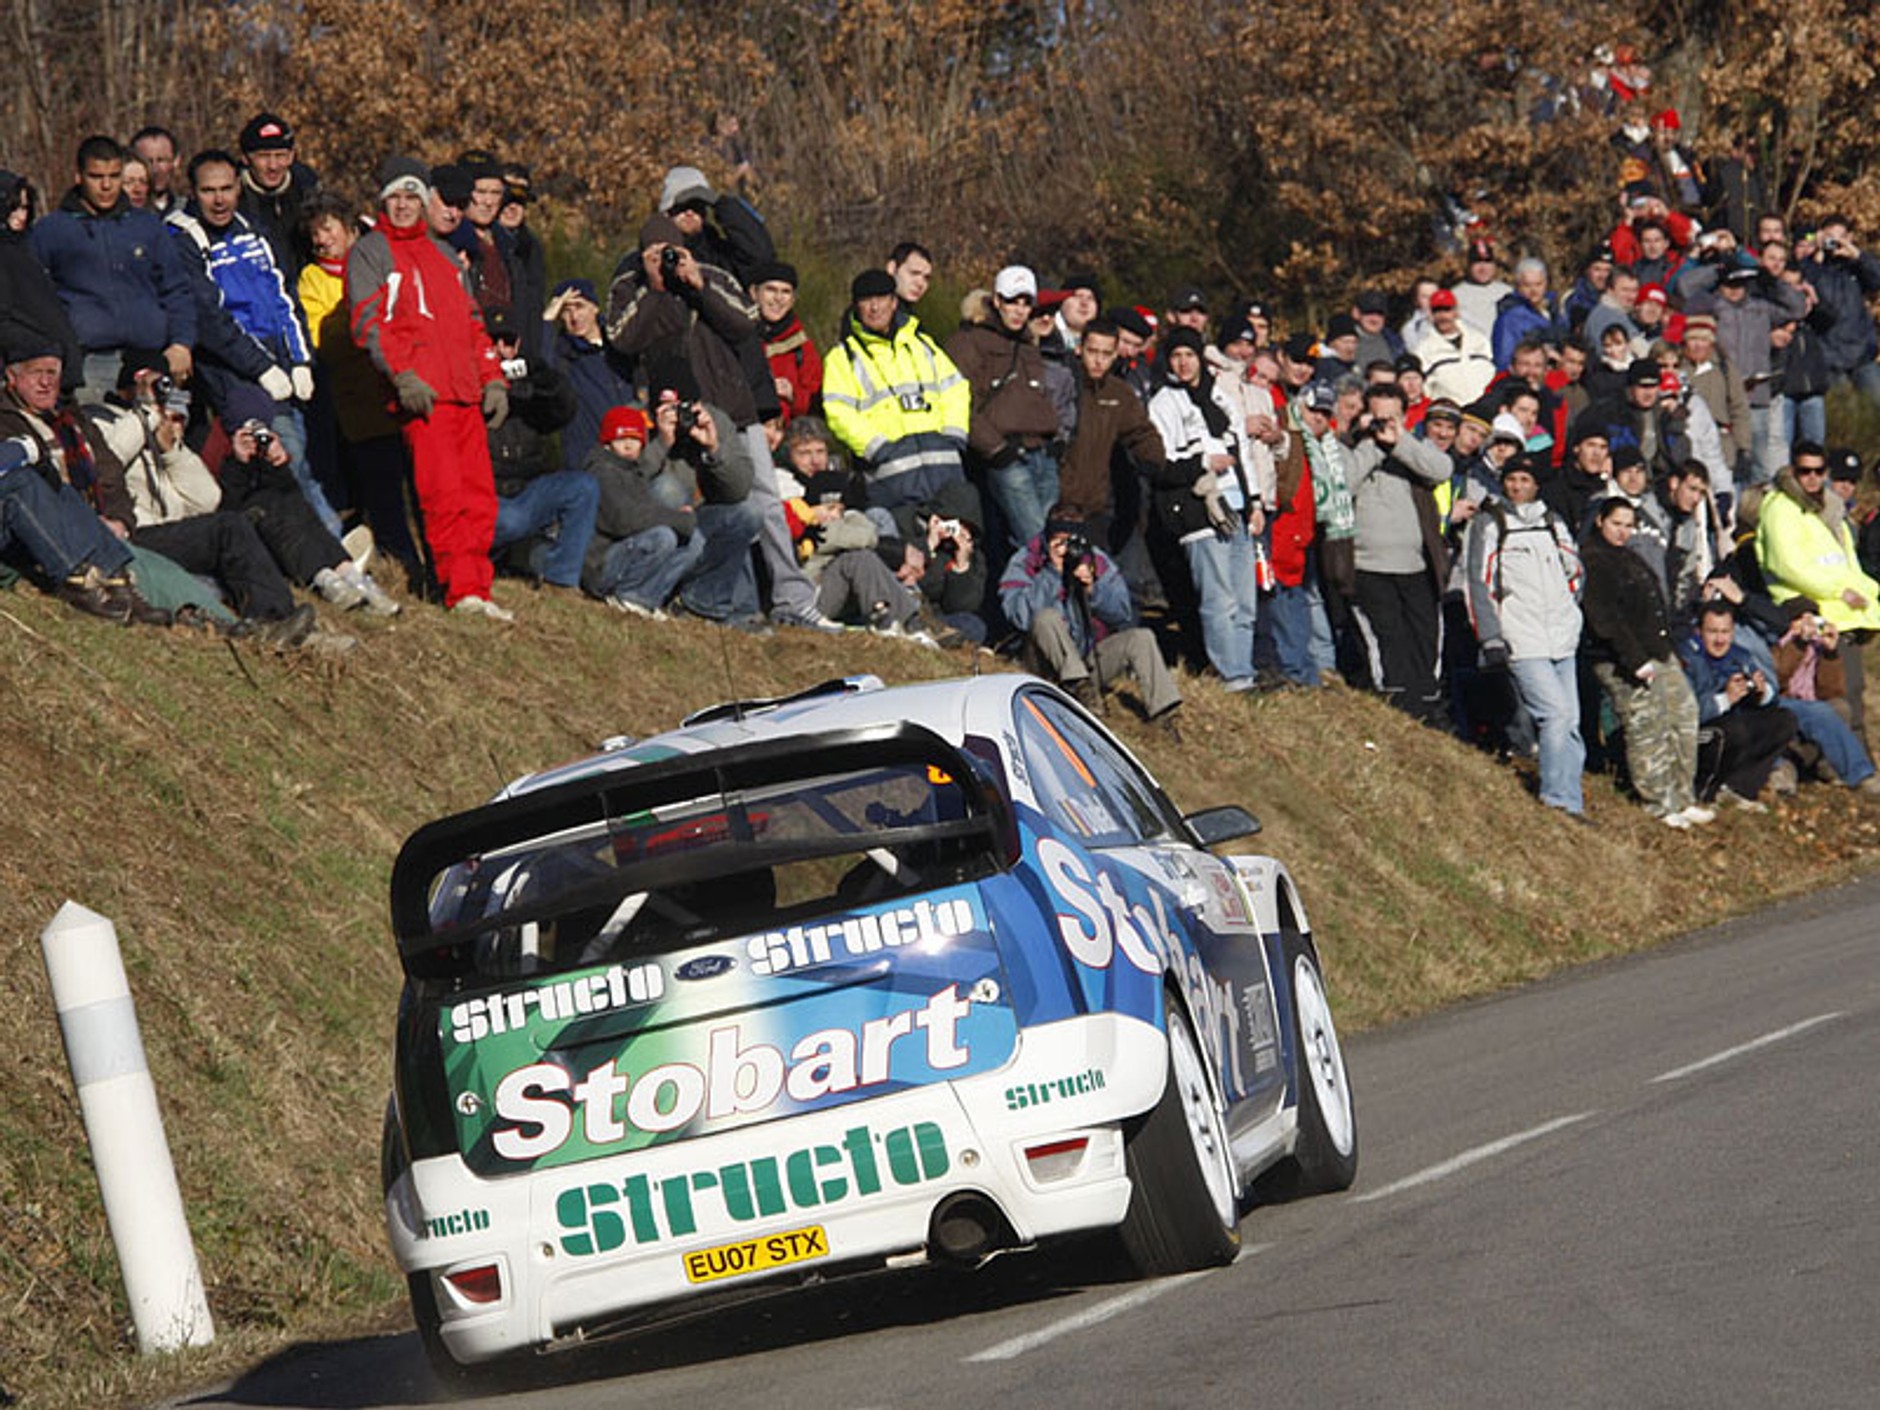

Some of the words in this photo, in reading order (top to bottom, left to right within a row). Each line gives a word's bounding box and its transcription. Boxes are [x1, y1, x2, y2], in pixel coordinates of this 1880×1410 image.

[493, 983, 972, 1160] Stobart
[689, 1243, 758, 1278] EU07
[769, 1231, 823, 1261] STX
